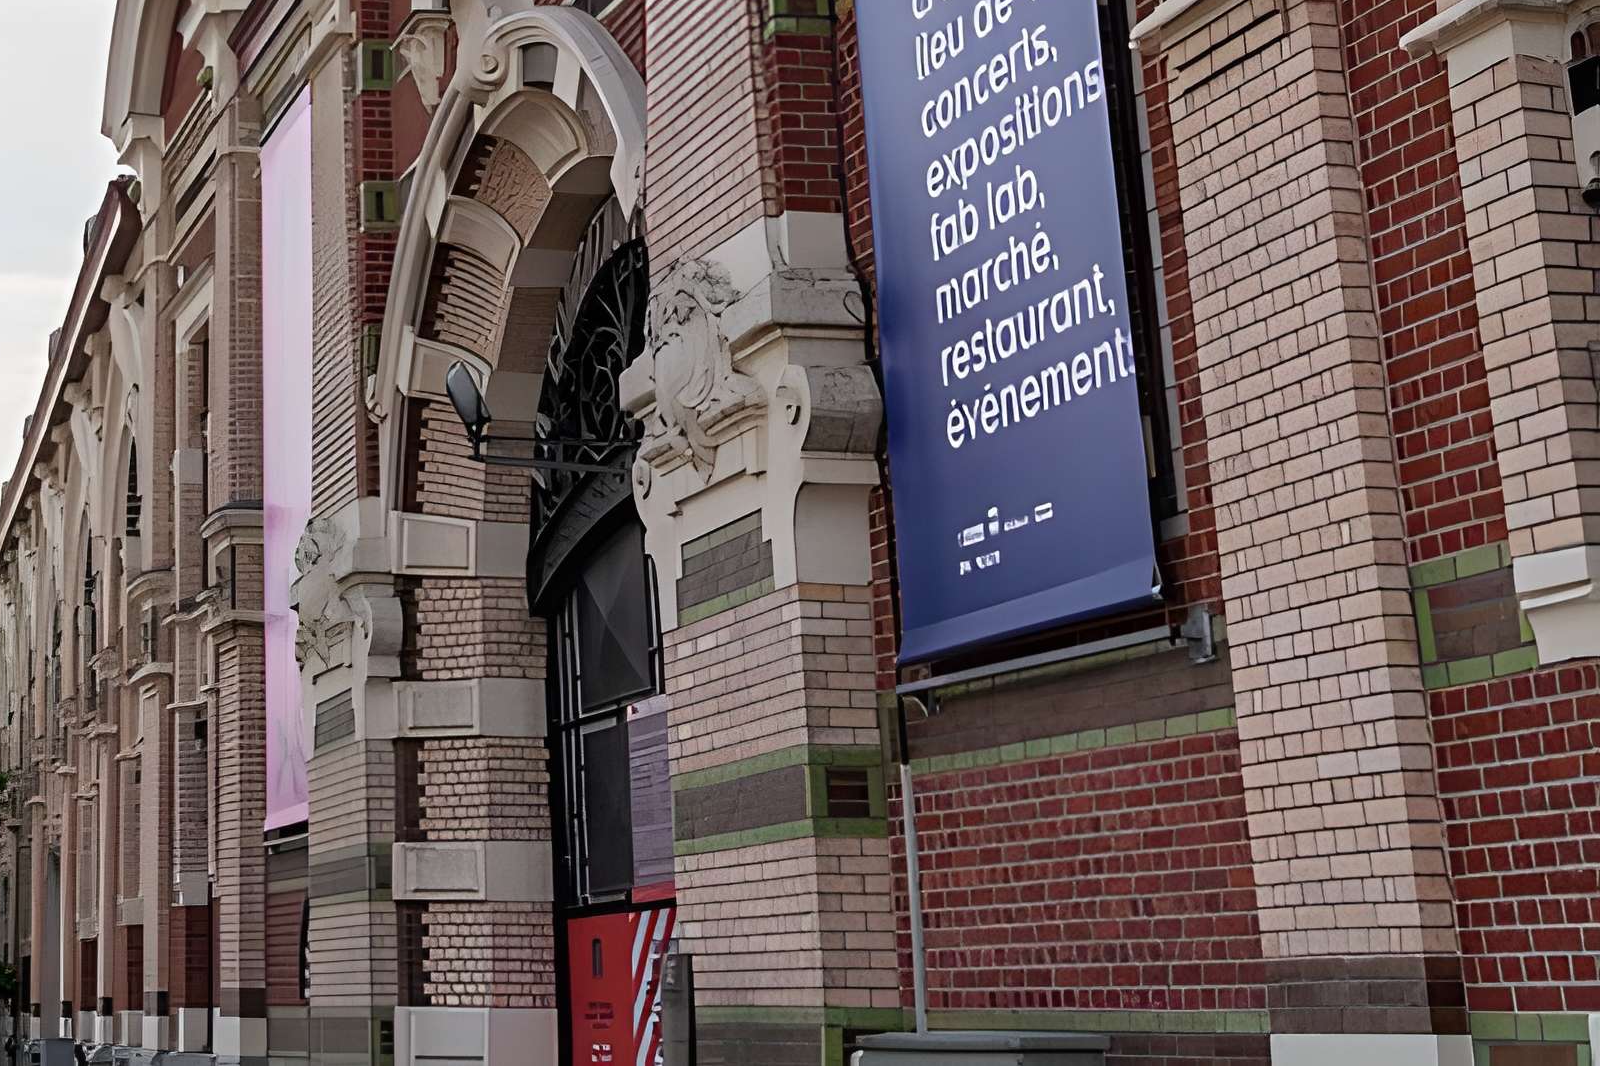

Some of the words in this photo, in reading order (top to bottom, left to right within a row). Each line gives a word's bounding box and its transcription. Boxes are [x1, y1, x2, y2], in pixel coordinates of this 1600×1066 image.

[915, 15, 964, 81] lieu
[921, 24, 1058, 138] concerts,
[930, 198, 979, 262] fab
[986, 164, 1046, 231] lab,
[936, 221, 1060, 324] marché,
[941, 263, 1116, 387] restaurant,
